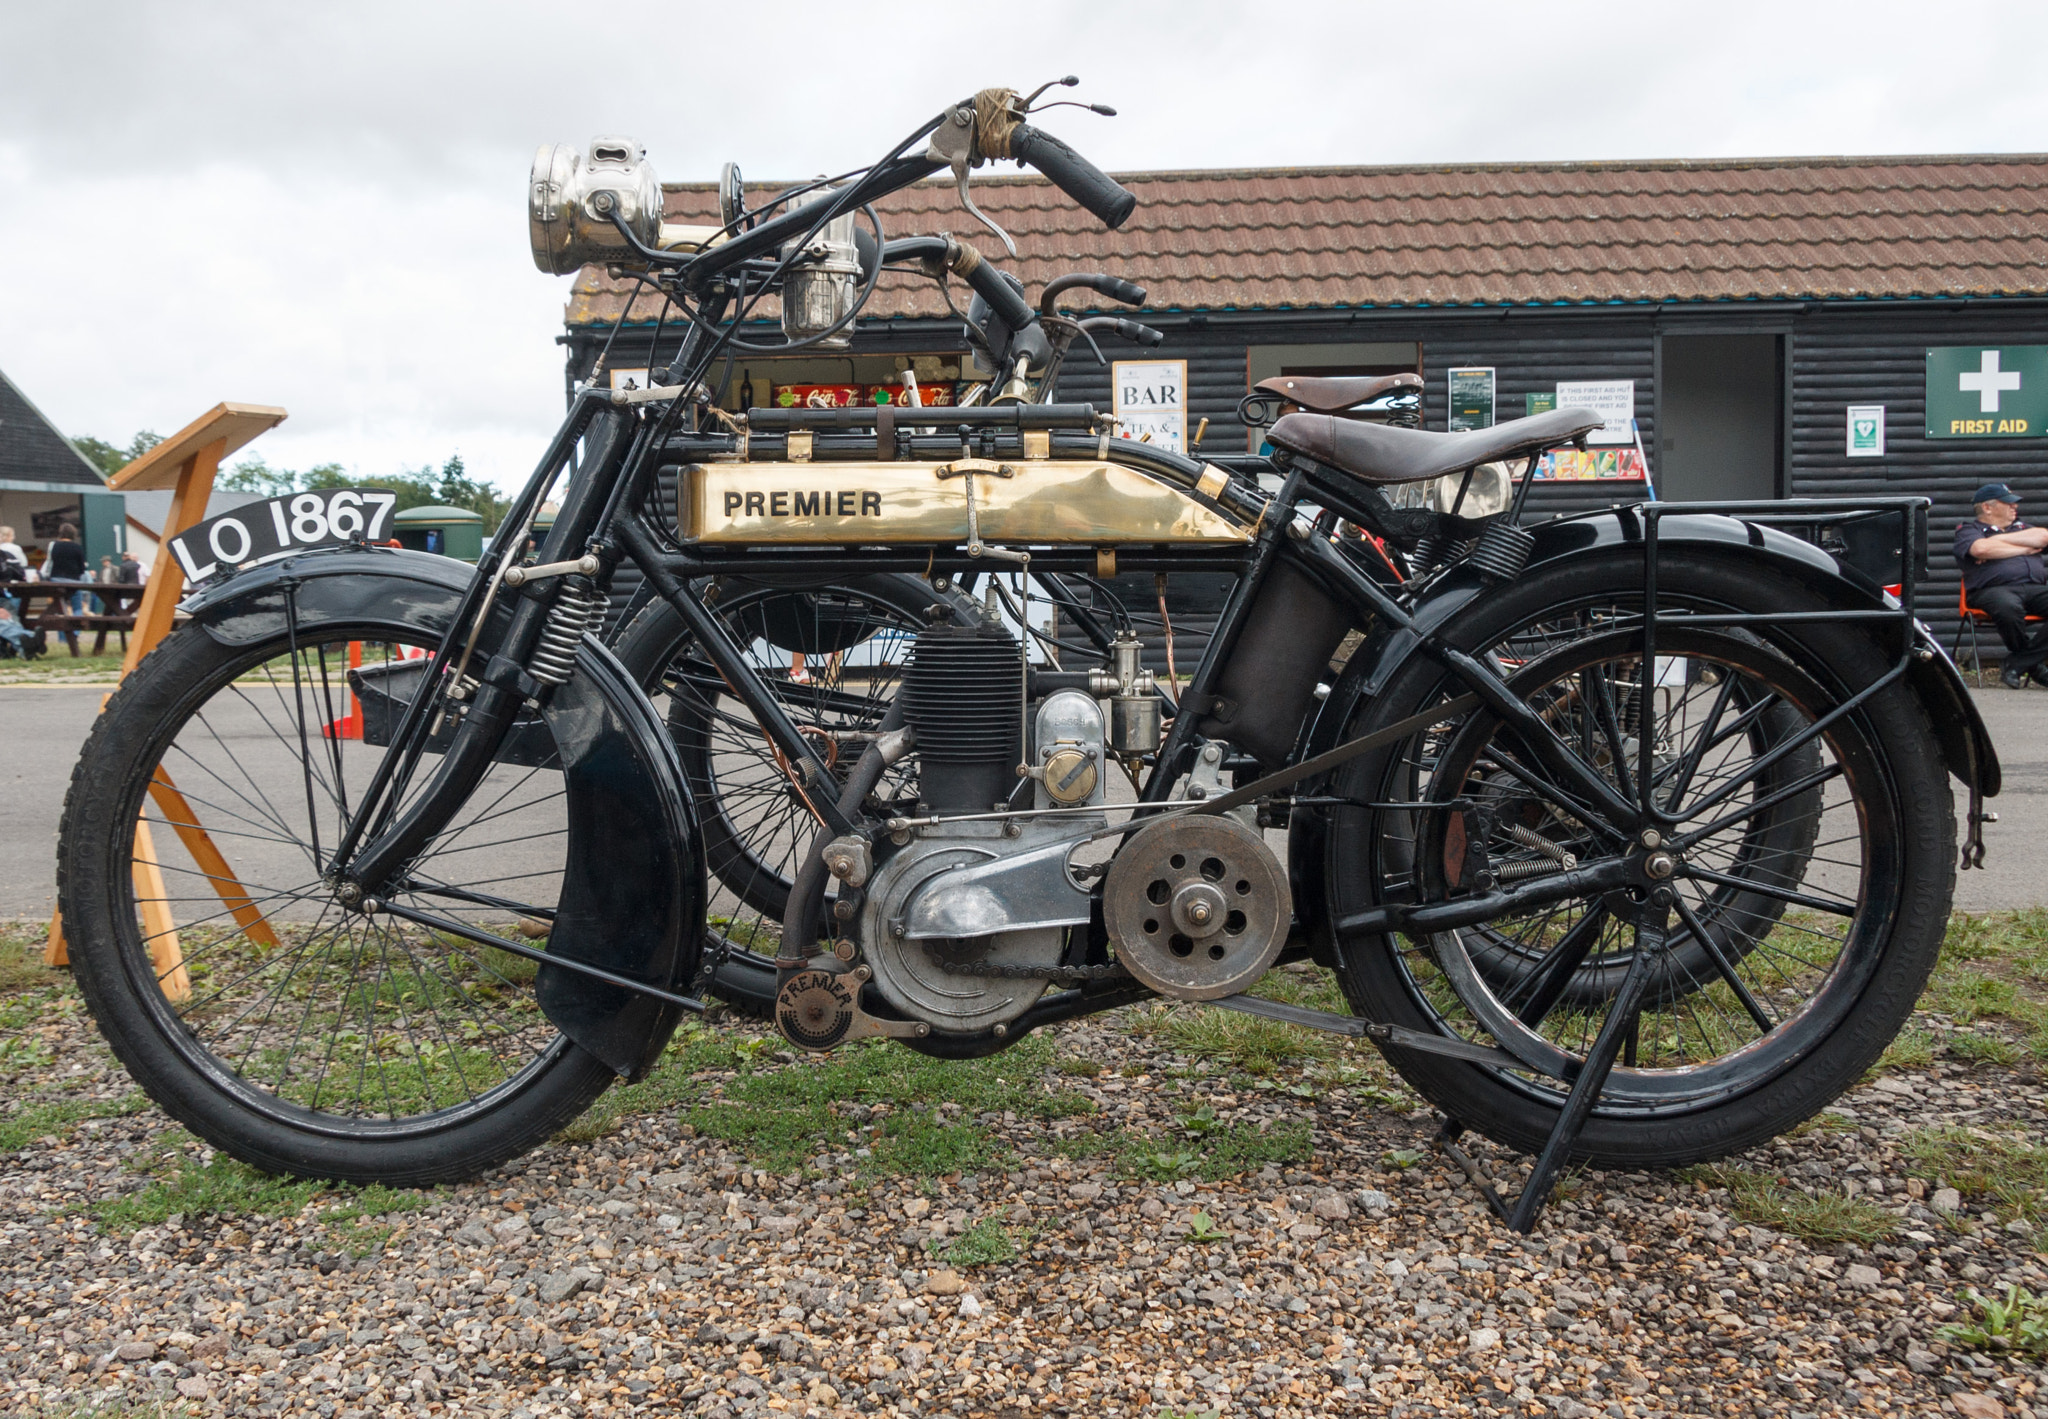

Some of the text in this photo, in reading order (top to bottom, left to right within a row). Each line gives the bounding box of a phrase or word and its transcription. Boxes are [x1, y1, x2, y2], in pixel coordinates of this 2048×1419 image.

[807, 388, 858, 407] Coca-Cla
[1122, 385, 1177, 405] BAR
[1129, 423, 1171, 433] TEA &
[1951, 419, 2028, 434] FIRST AID
[724, 490, 882, 517] PREMIER
[172, 490, 396, 583] LO 1867
[780, 974, 852, 1007] PREMIER
